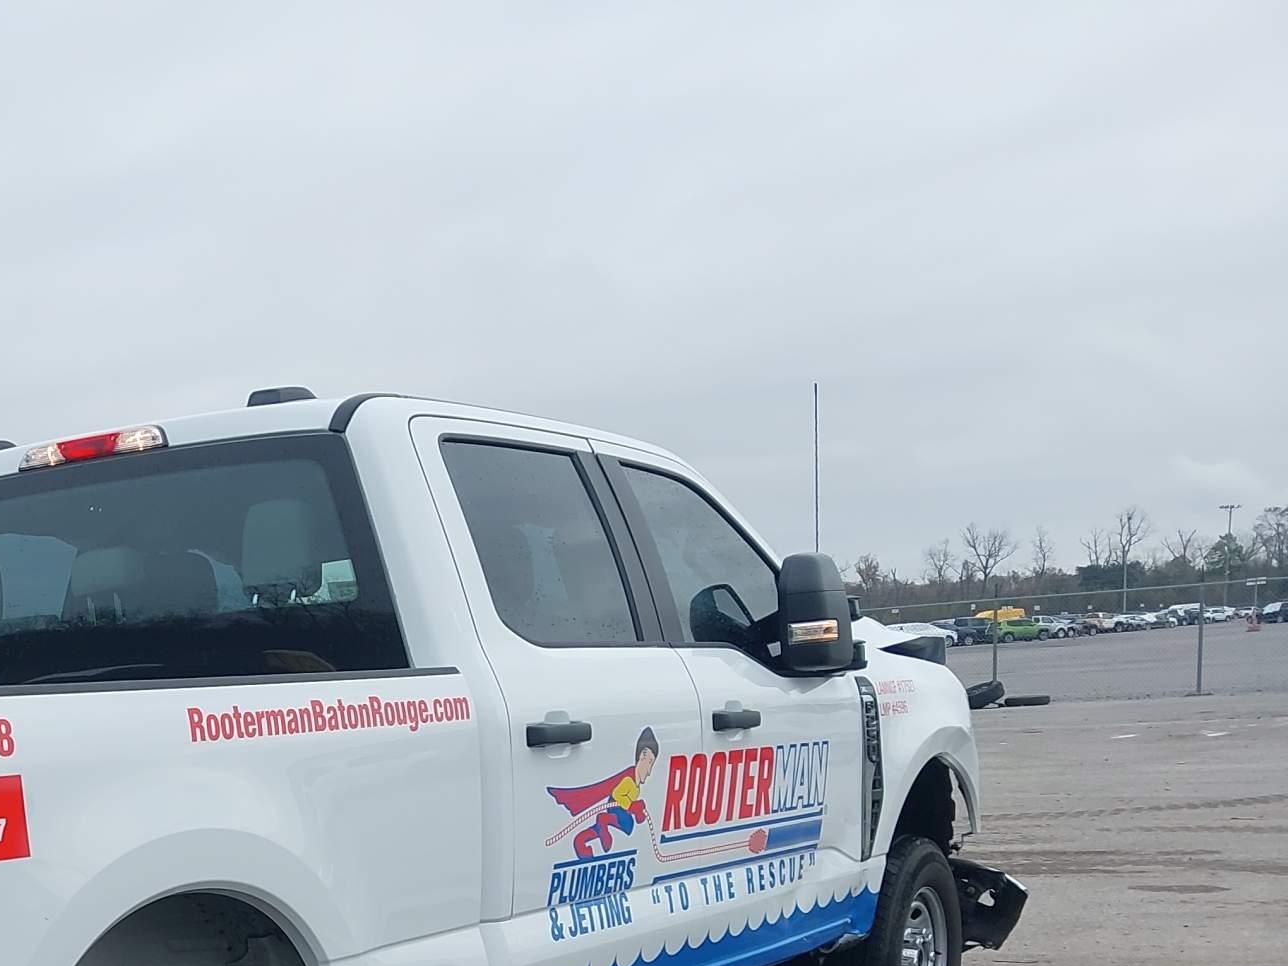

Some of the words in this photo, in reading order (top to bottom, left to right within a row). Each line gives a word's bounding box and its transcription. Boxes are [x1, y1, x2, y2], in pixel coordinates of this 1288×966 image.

[187, 695, 471, 742] RootermanBatonRouge.com
[547, 857, 636, 907] PLUMBERS
[701, 871, 735, 905] THE
[549, 907, 564, 941] &
[568, 892, 633, 938] JETTING
